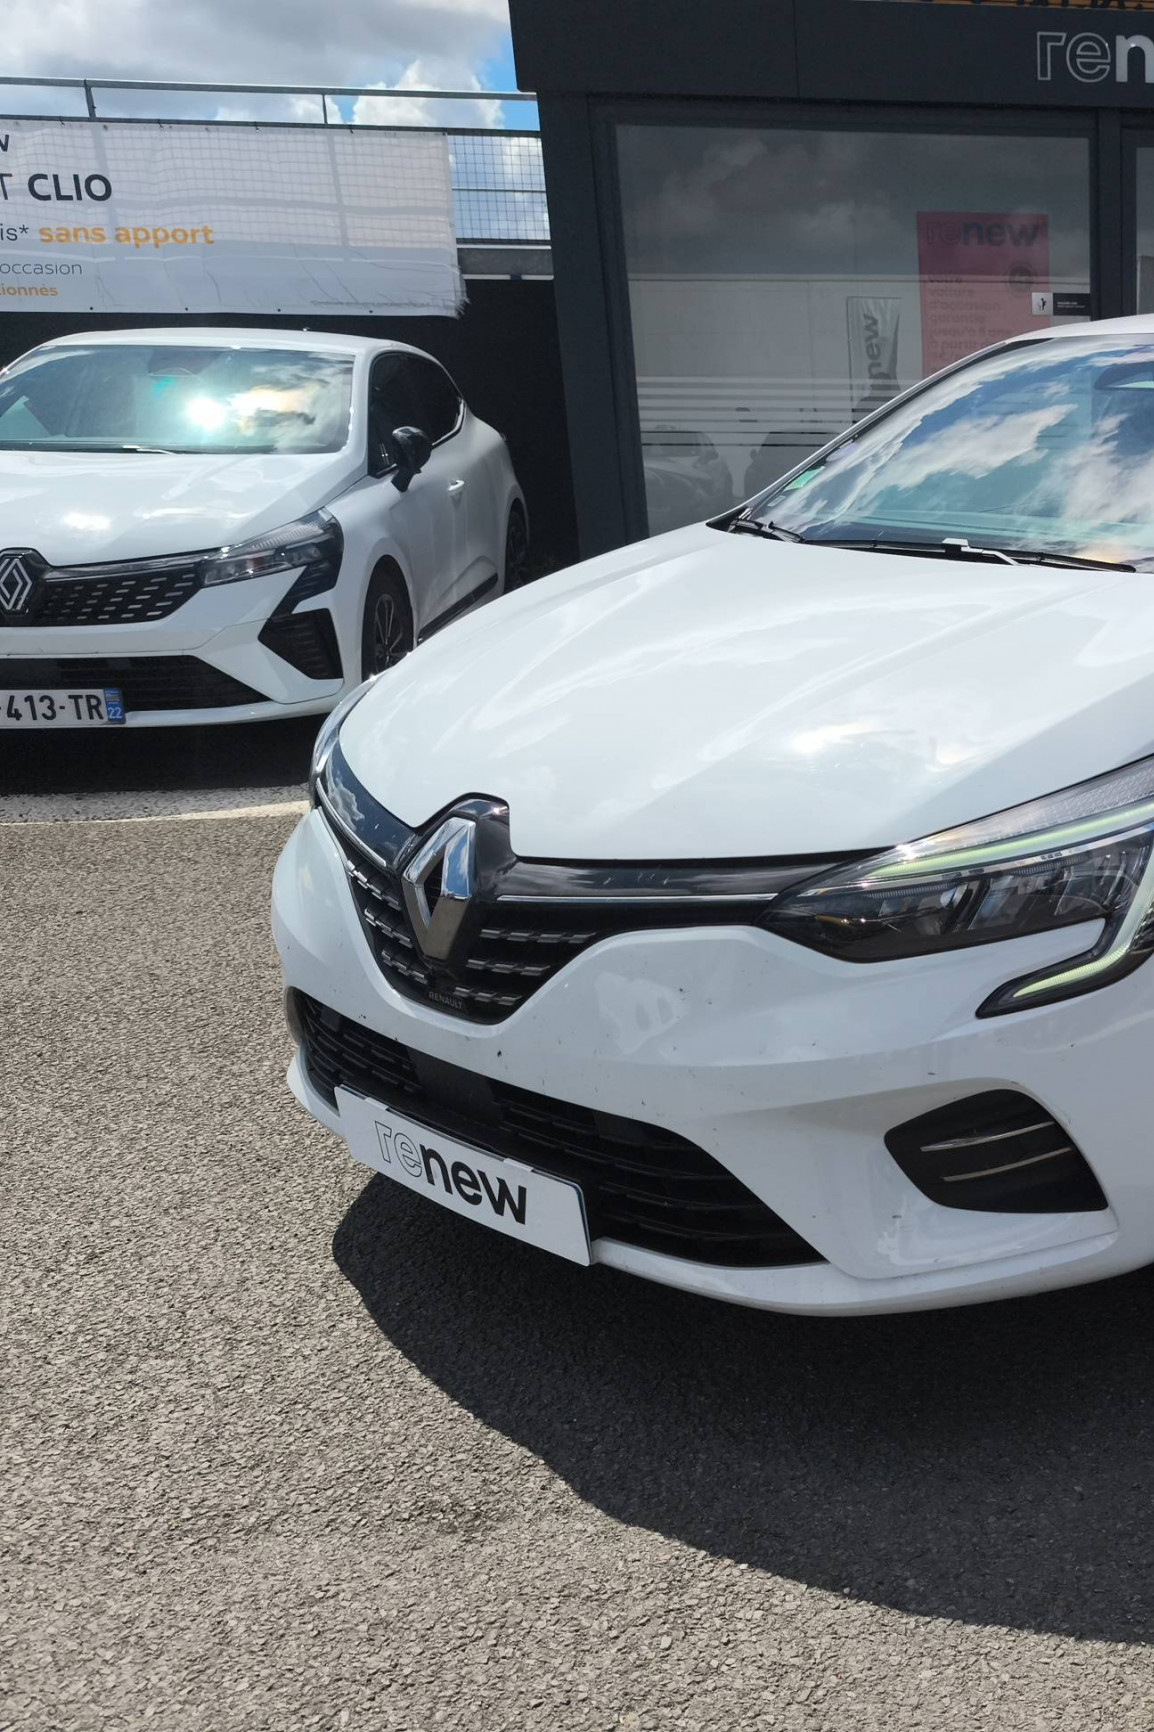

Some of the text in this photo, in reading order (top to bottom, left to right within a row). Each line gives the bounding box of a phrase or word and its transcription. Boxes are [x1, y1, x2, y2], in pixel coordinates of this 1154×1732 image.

[27, 173, 112, 202] CLIO
[38, 226, 106, 243] sans
[115, 224, 214, 249] apport
[926, 220, 1040, 248] renew
[0, 262, 82, 276] occasion
[0, 694, 104, 721] 413-TR
[107, 706, 122, 719] 22
[428, 990, 462, 1009] RENAULT
[374, 1120, 527, 1226] renew
